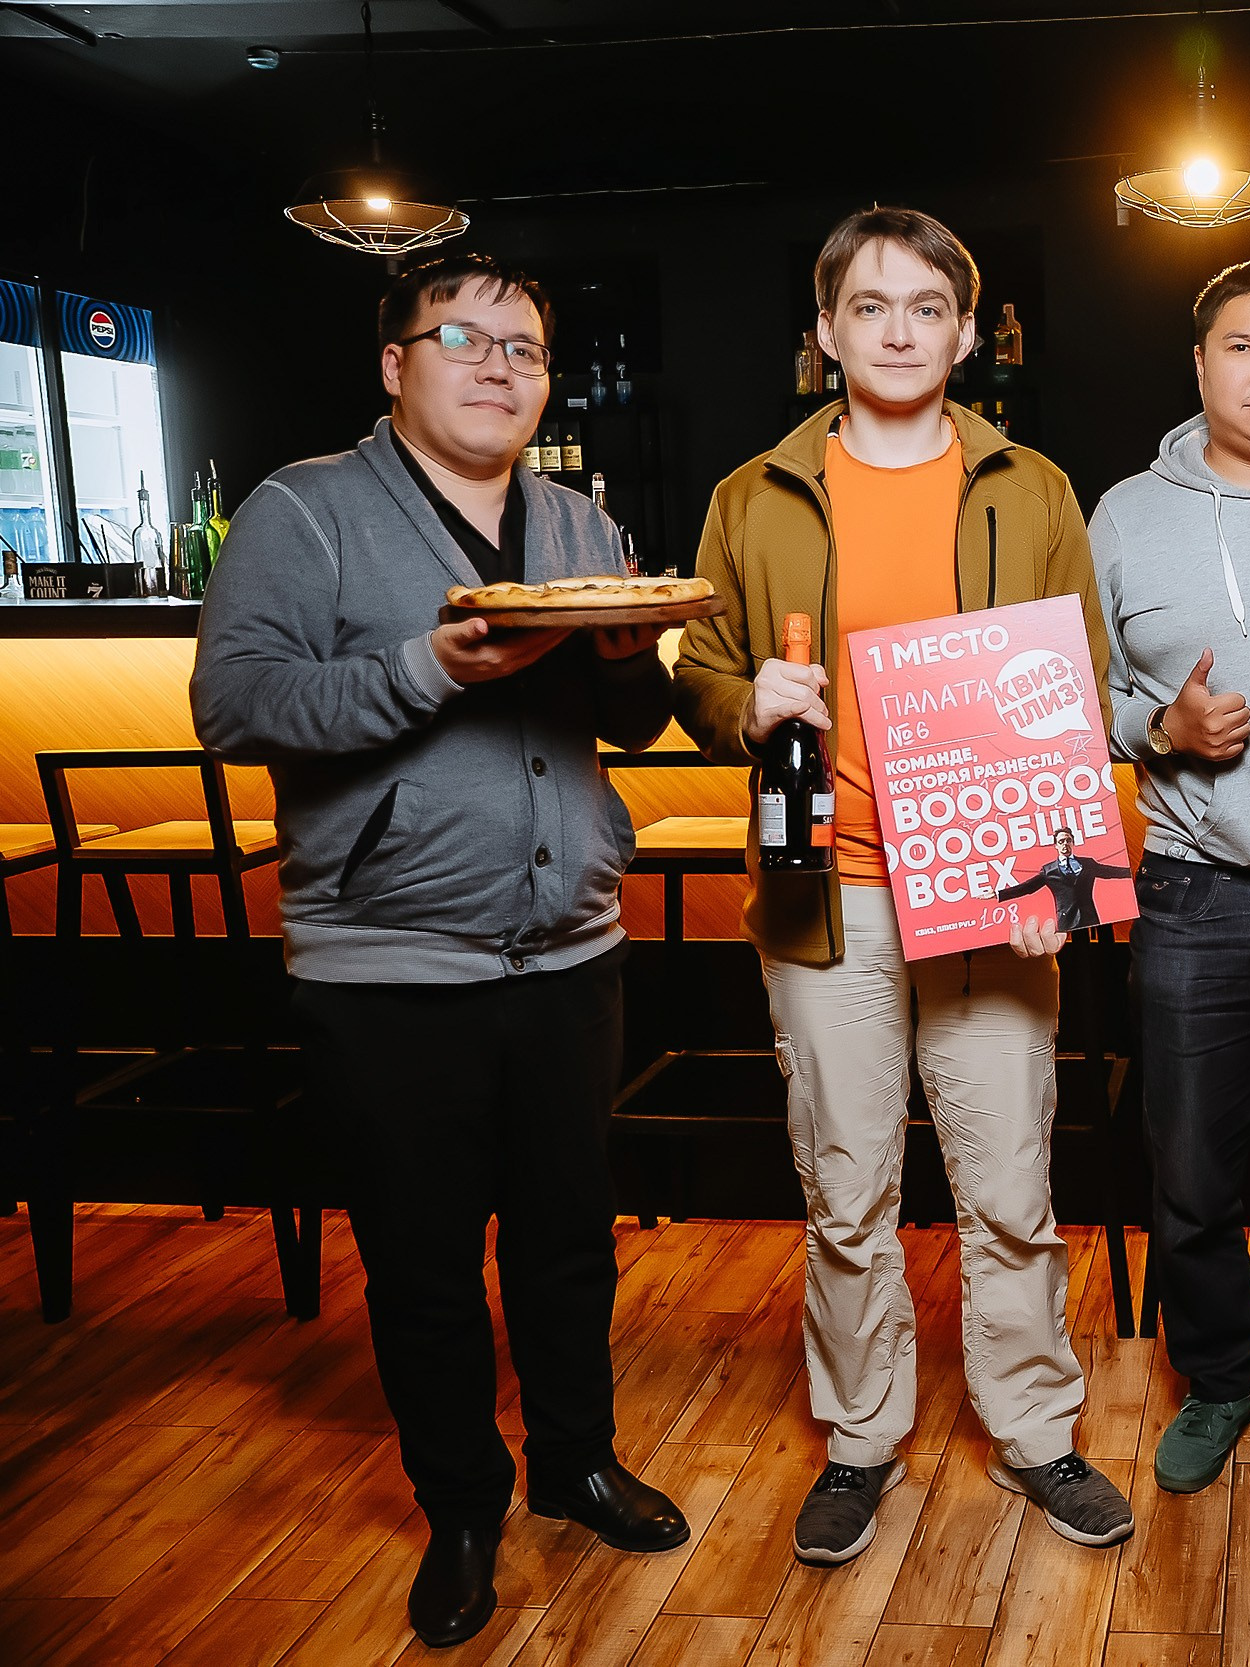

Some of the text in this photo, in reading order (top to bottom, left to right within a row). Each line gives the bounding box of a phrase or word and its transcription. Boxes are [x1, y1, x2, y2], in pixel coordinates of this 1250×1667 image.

[92, 324, 114, 335] PEPSI
[29, 576, 65, 587] MAKE IT
[30, 587, 67, 598] COUNT
[867, 624, 1011, 673] 1 МЕСТО
[880, 678, 994, 720] ПАЛАТА
[884, 747, 979, 776] КОМАНДЕ,
[888, 750, 1066, 796] КОТОРАЯ РАЗНЕСЛА
[905, 856, 1020, 910] ВСЕХ
[978, 902, 1020, 931] 108
